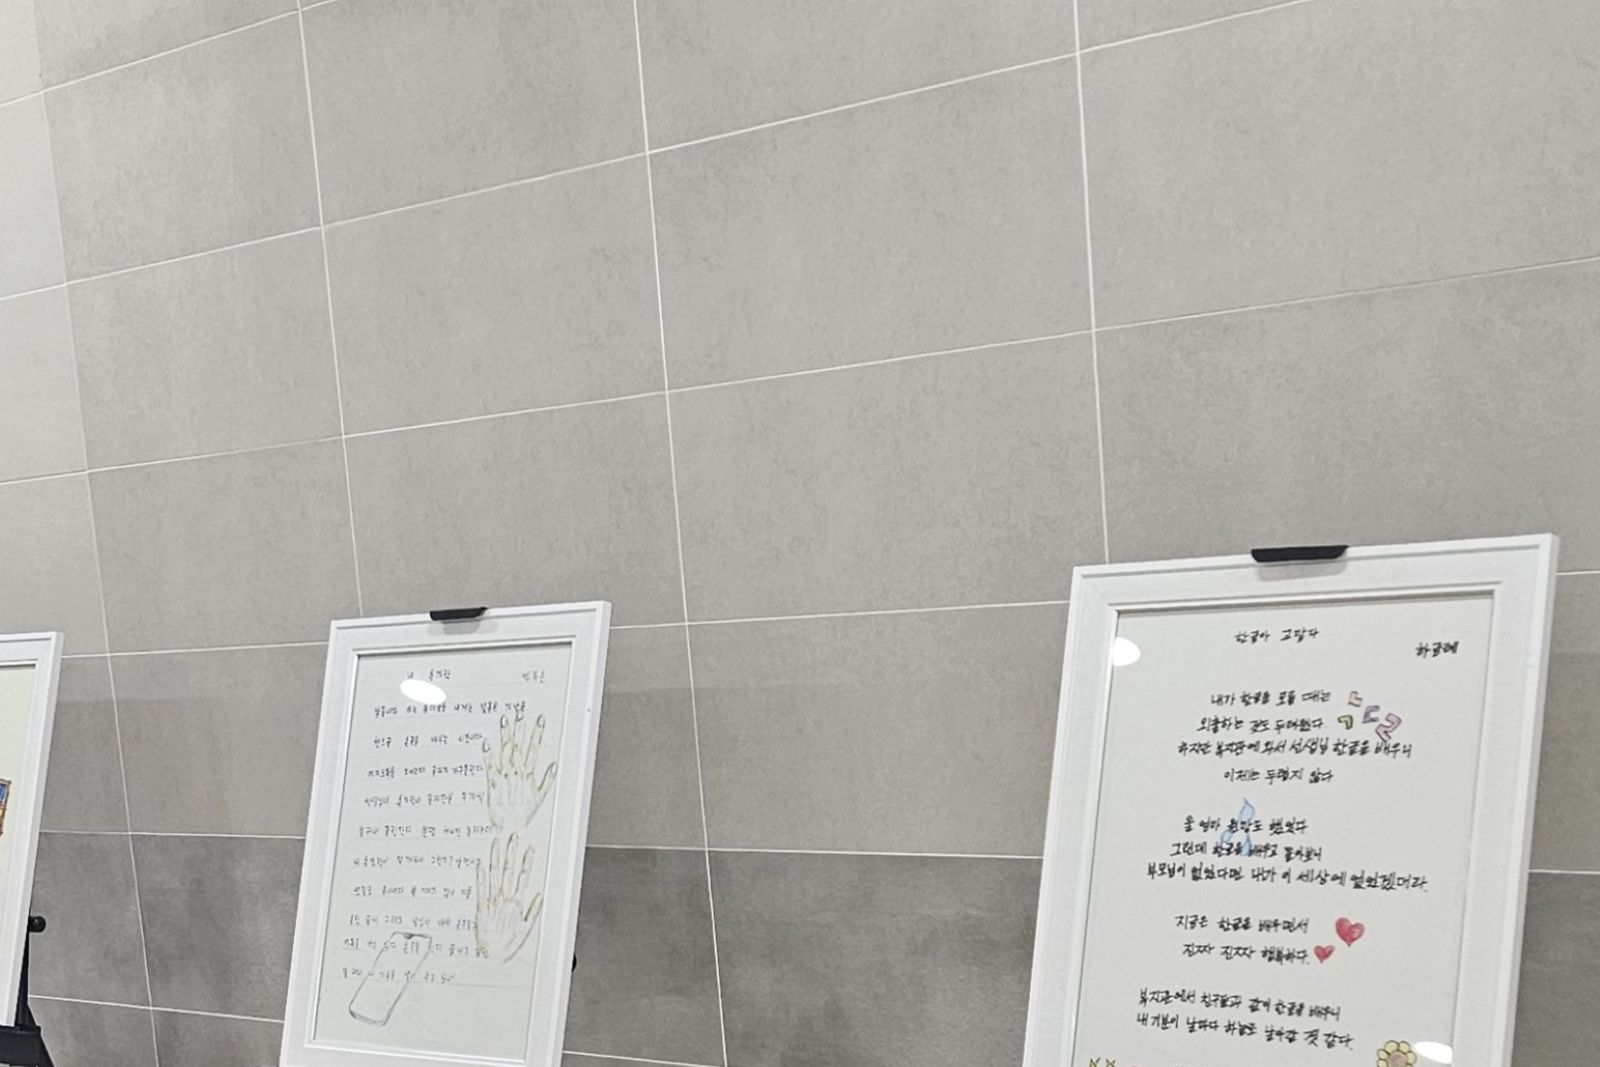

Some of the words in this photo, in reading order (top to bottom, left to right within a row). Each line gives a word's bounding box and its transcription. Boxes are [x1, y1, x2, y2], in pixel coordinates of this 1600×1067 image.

[1211, 694, 1235, 705] 내가
[1177, 740, 1211, 756] 하지만
[1170, 841, 1207, 856] 그런데
